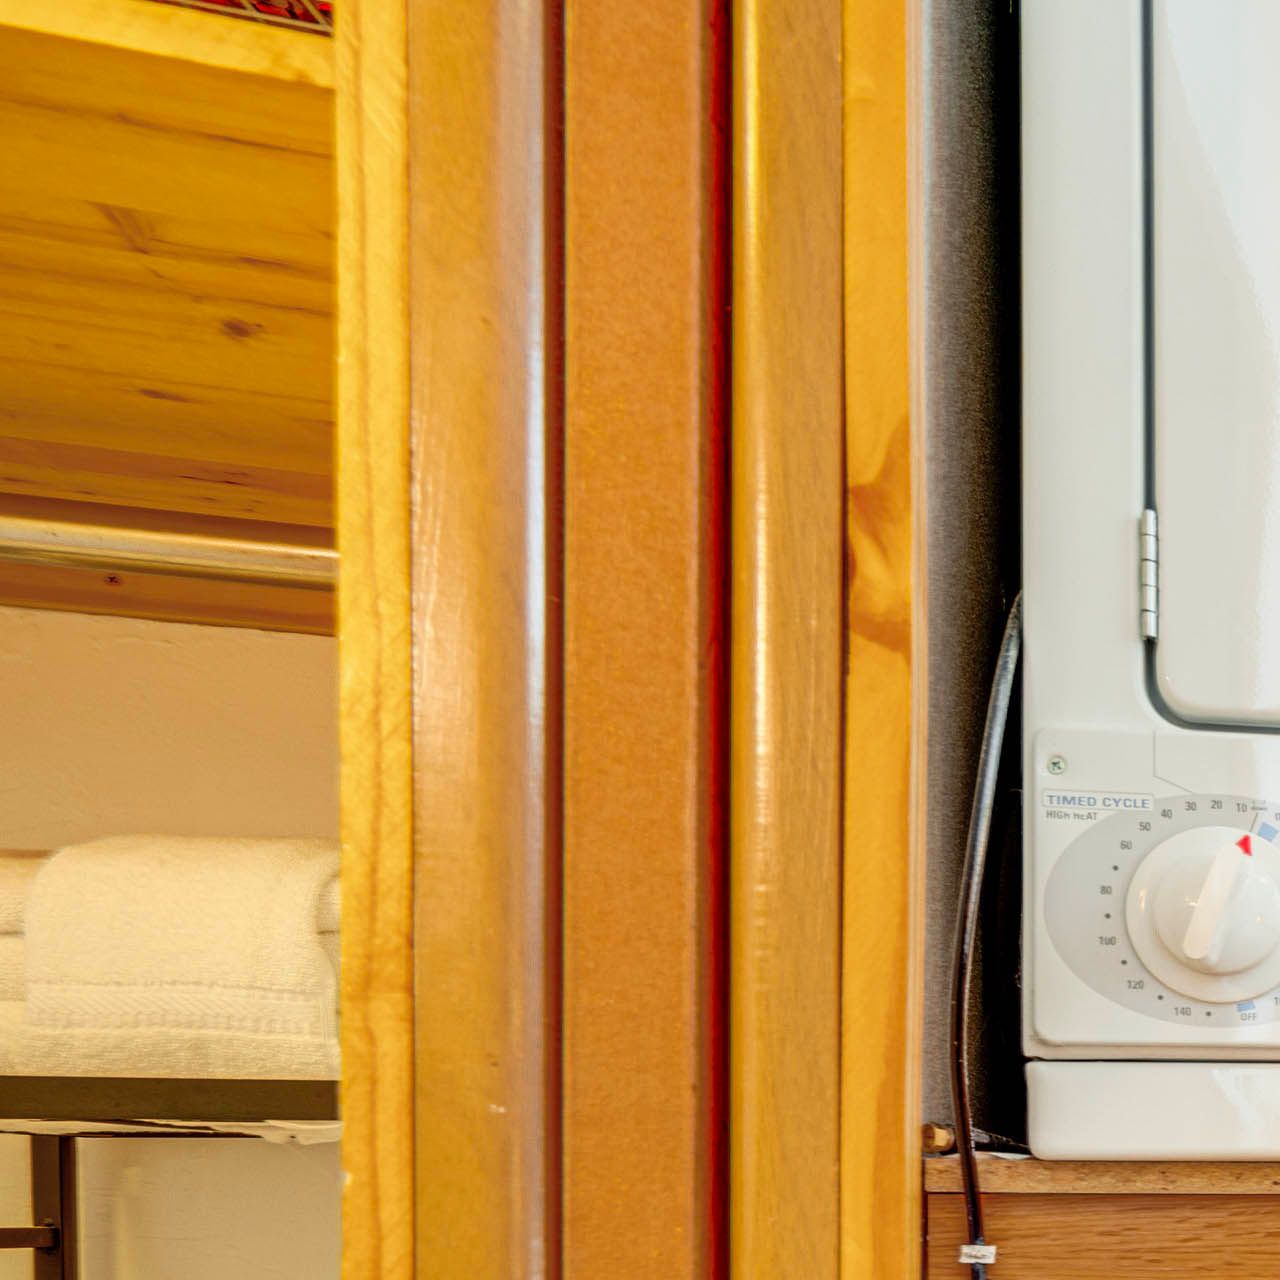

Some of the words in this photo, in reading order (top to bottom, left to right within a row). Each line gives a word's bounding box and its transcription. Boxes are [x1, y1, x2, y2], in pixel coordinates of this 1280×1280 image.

[1046, 795, 1097, 807] TIMED
[1102, 797, 1150, 809] CYCLE
[1184, 801, 1197, 812] 30
[1210, 800, 1223, 810] 20
[1237, 803, 1248, 813] 10
[1046, 811, 1069, 820] HIGH
[1073, 812, 1097, 821] HEAT
[1160, 809, 1173, 819] 40
[1139, 822, 1151, 832] 50
[1100, 885, 1112, 895] 80
[1127, 980, 1144, 990] 120
[1174, 1007, 1192, 1016] 140
[1240, 1013, 1256, 1021] OFF
